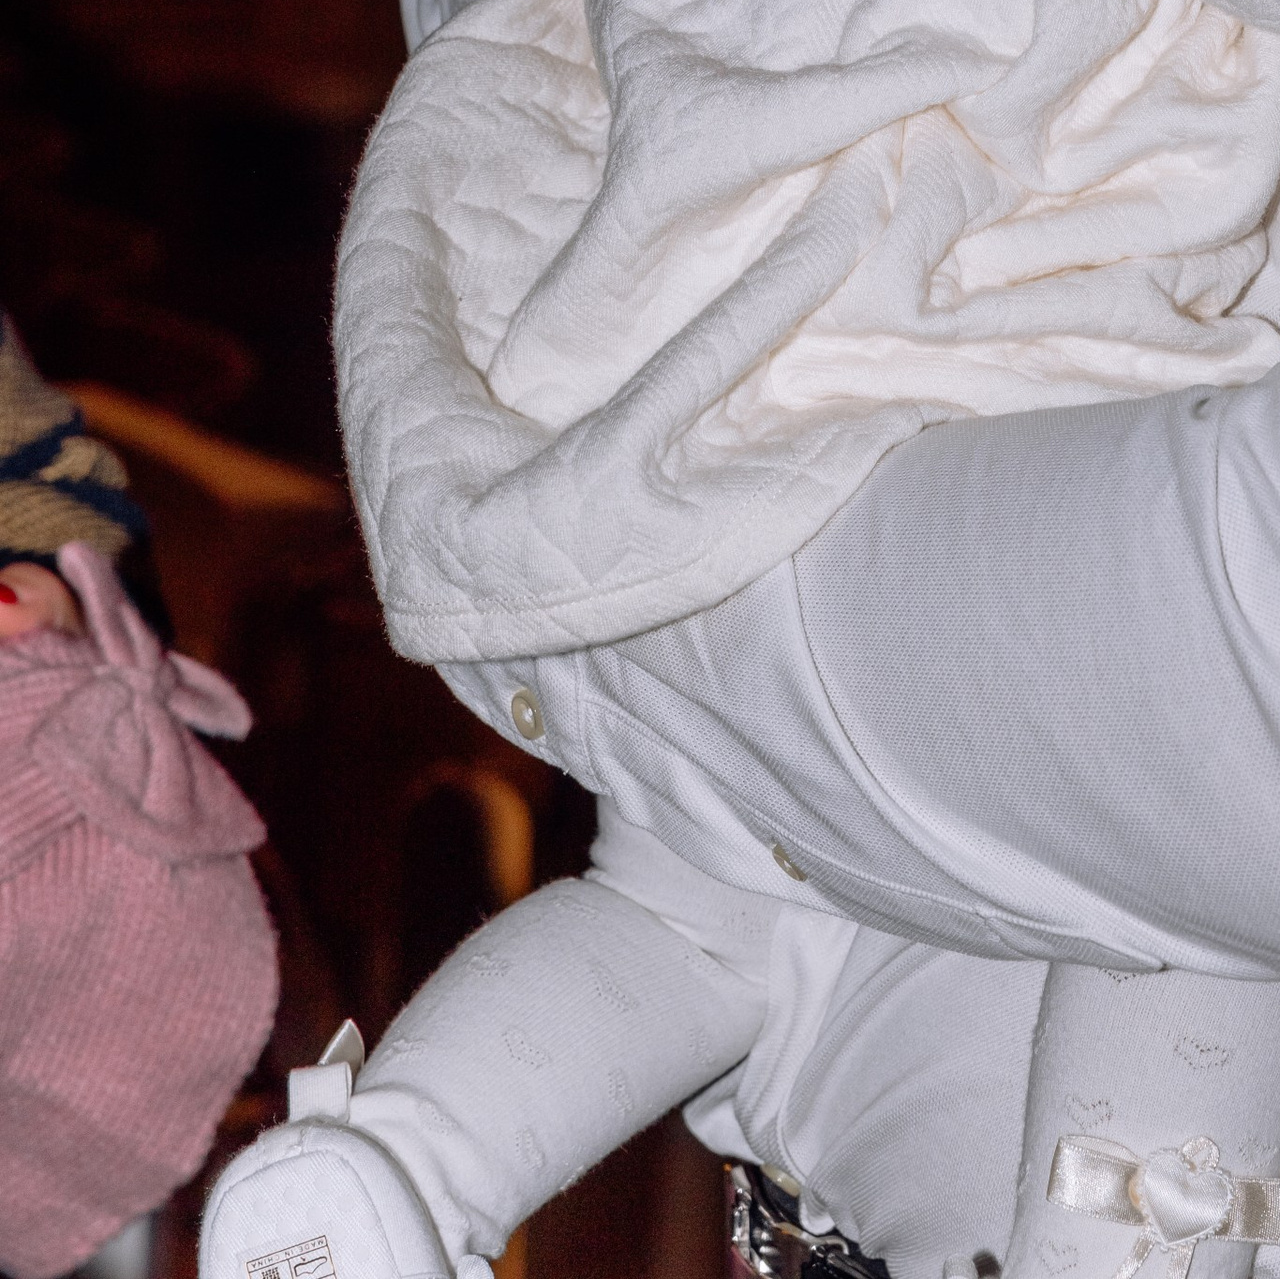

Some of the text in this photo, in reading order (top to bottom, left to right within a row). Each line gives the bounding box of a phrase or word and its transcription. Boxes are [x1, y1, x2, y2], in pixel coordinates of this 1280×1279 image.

[250, 1240, 324, 1269] MADE IN CHINA
